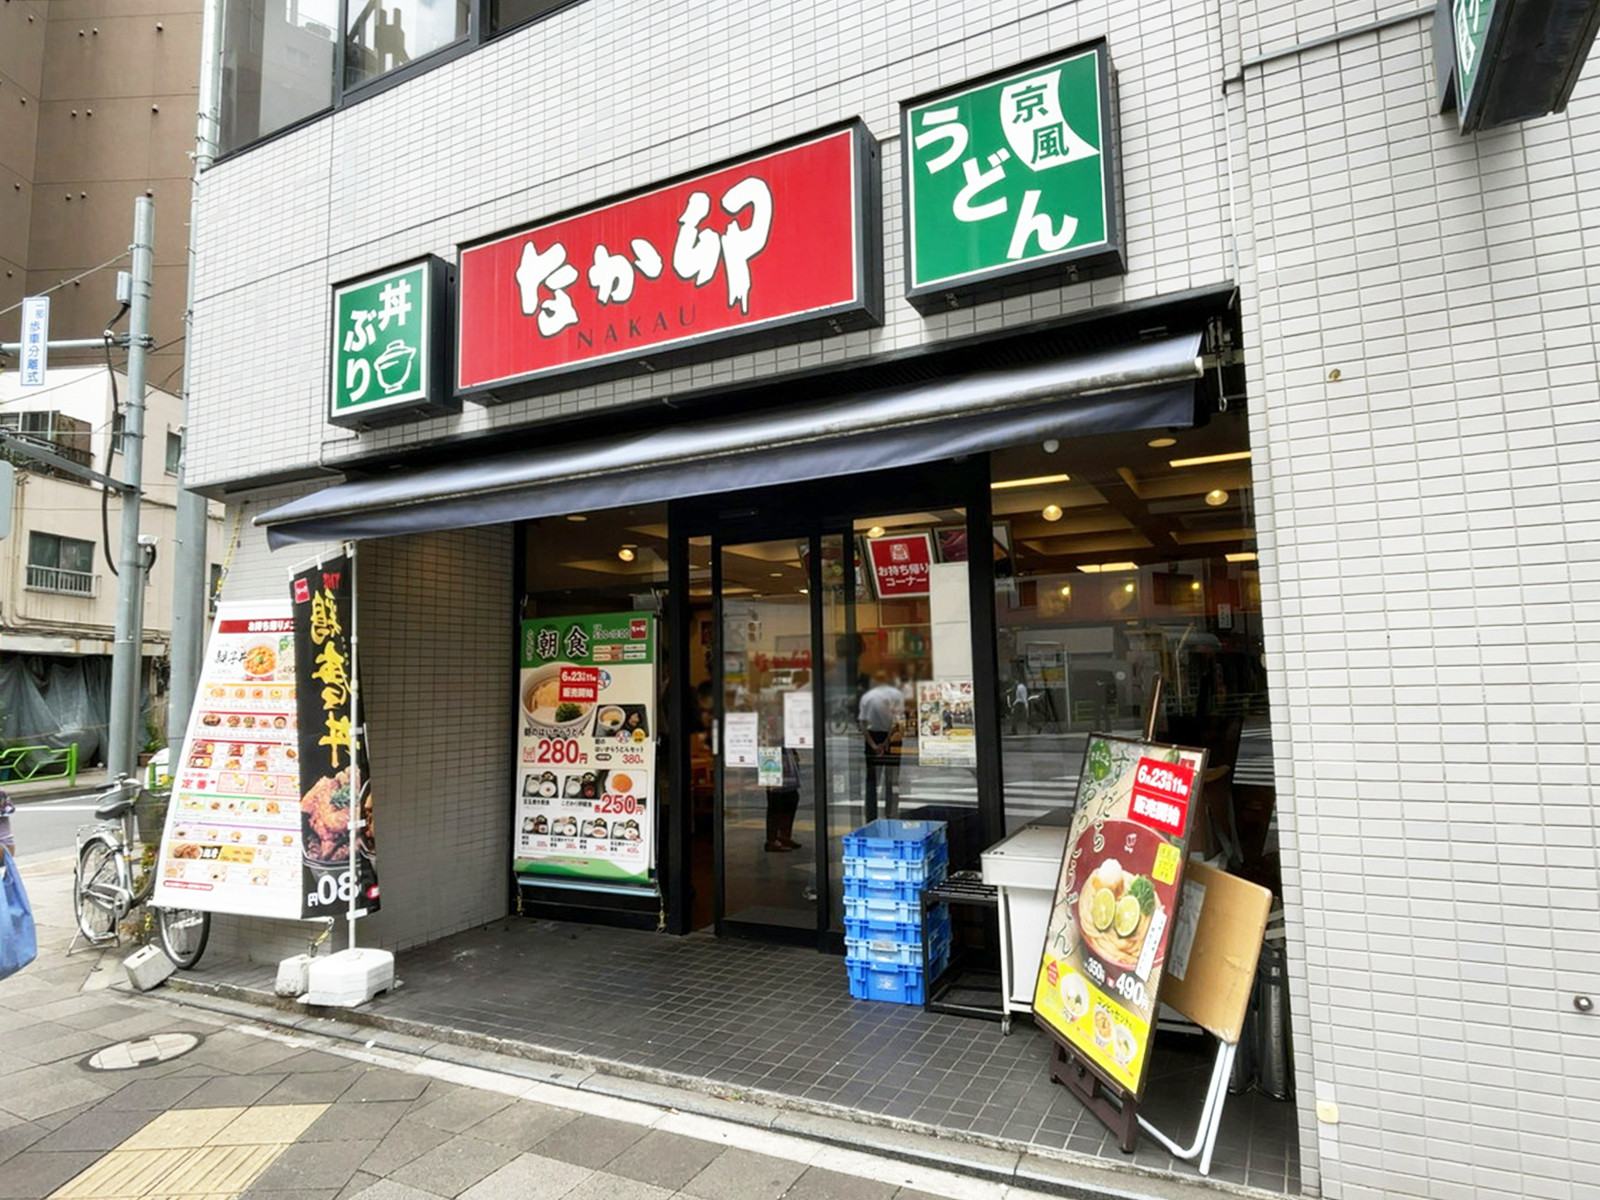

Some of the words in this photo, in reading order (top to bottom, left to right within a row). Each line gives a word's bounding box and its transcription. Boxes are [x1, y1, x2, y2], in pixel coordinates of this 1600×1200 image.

[1011, 85, 1070, 164] 京風
[915, 105, 1079, 259] うどん
[515, 176, 774, 338] なか卯
[577, 304, 697, 349] NAKAU
[878, 563, 930, 576] お持ち帰り
[886, 576, 927, 587] コーナー
[537, 625, 589, 659] 朝食
[537, 739, 588, 765] 280円
[1133, 794, 1181, 827] 販売開始
